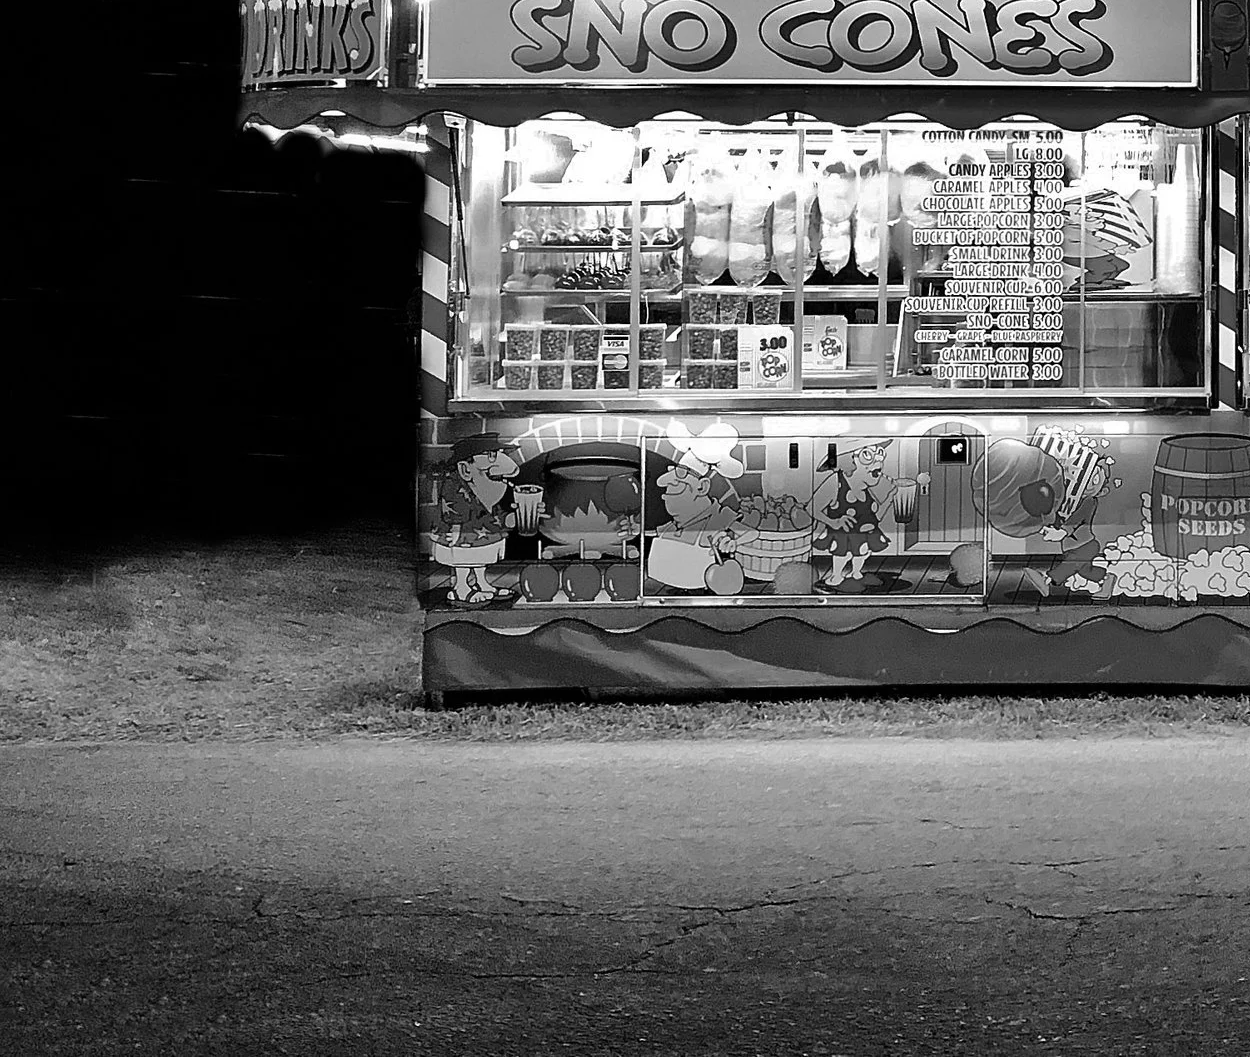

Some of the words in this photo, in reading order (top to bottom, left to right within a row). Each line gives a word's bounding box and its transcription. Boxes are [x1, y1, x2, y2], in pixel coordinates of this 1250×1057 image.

[922, 130, 965, 143] COTTON
[968, 130, 1006, 143] CANDY
[1012, 130, 1030, 143] SM
[1035, 130, 1063, 143] 5.00
[1016, 148, 1029, 160] LG
[1035, 148, 1063, 160] 8.00
[949, 164, 986, 177] CANDY
[989, 164, 1030, 177] APPLES
[1035, 164, 1063, 177] 3.00
[933, 180, 985, 193] CARAMEL
[989, 180, 1030, 193] APPLES
[922, 197, 985, 210] CHOCOLATE
[989, 197, 1030, 210] APPLES
[939, 214, 974, 227] LARGE
[977, 214, 1029, 227] POPCORN
[914, 231, 955, 244] BUCKET
[958, 231, 975, 244] OF
[977, 231, 1029, 244] POPCORN
[952, 247, 989, 260] SMALL
[993, 247, 1029, 260] DRINK
[954, 264, 988, 277] LARGE
[992, 264, 1028, 277] DRINK
[1034, 264, 1062, 277] 4.00
[946, 281, 1005, 293] SOUVENIR
[1006, 281, 1026, 293] CUP
[906, 298, 963, 311] SOUVENIR
[966, 298, 988, 311] CUP
[991, 298, 1028, 311] REFILL
[968, 315, 1029, 327] SNO-CONE
[916, 331, 948, 341] CHERRY
[957, 331, 983, 341] GRAPE
[992, 331, 1013, 341] BLUE
[1015, 331, 1062, 341] RASPBERRY
[760, 336, 787, 351] 3.00
[942, 349, 994, 361] CARAMEL
[997, 349, 1027, 361] CORN
[1034, 349, 1062, 361] 5.00
[939, 366, 986, 378] BOTTLED
[990, 366, 1027, 378] WATER
[1034, 366, 1061, 378] 3.00
[1178, 518, 1246, 536] SEEDS
